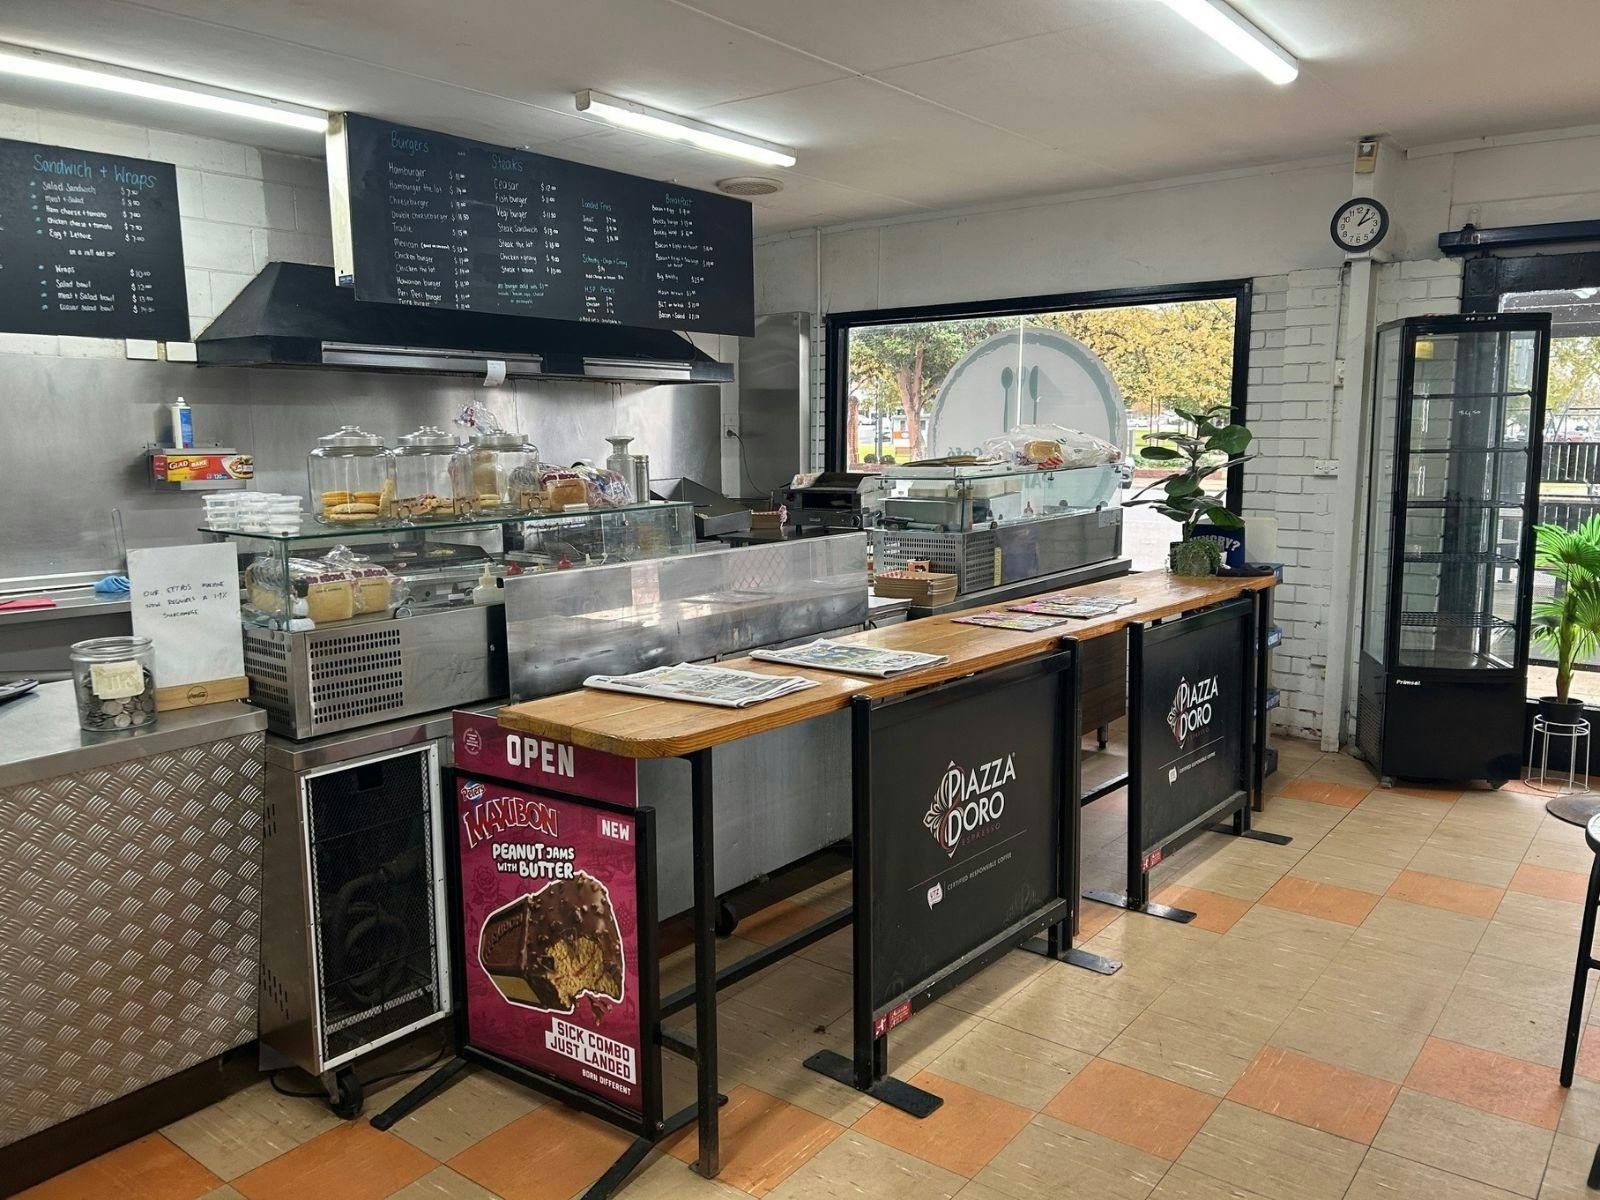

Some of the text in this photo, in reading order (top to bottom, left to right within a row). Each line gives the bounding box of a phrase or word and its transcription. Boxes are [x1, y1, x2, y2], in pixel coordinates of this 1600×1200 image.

[391, 130, 429, 156] Burgers
[33, 154, 157, 190] Sandwich + Wraps
[388, 161, 426, 182] Hamburger
[491, 153, 524, 172] Steaks
[42, 180, 64, 192] Salad
[65, 182, 97, 196] Sandwich
[1372, 219, 1378, 227] 3
[48, 228, 63, 240] Egg
[54, 264, 76, 275] Wraps
[55, 279, 74, 289] Salad
[79, 291, 98, 301] Salad
[168, 460, 189, 469] GLAD
[1181, 675, 1219, 712] PIAZZA
[506, 734, 575, 778] OPEN
[948, 753, 1016, 808] PIAZZA
[461, 783, 486, 801] Peters
[463, 797, 558, 849] MAXIBON
[602, 819, 630, 841] NEW
[492, 843, 575, 860] PEANUT JAMS
[497, 860, 574, 879] WITH BUTTER
[557, 1020, 630, 1063] SICK COMBO
[550, 1036, 631, 1080] JUST LANDED
[582, 1069, 632, 1096] BORN DIFFERENT
